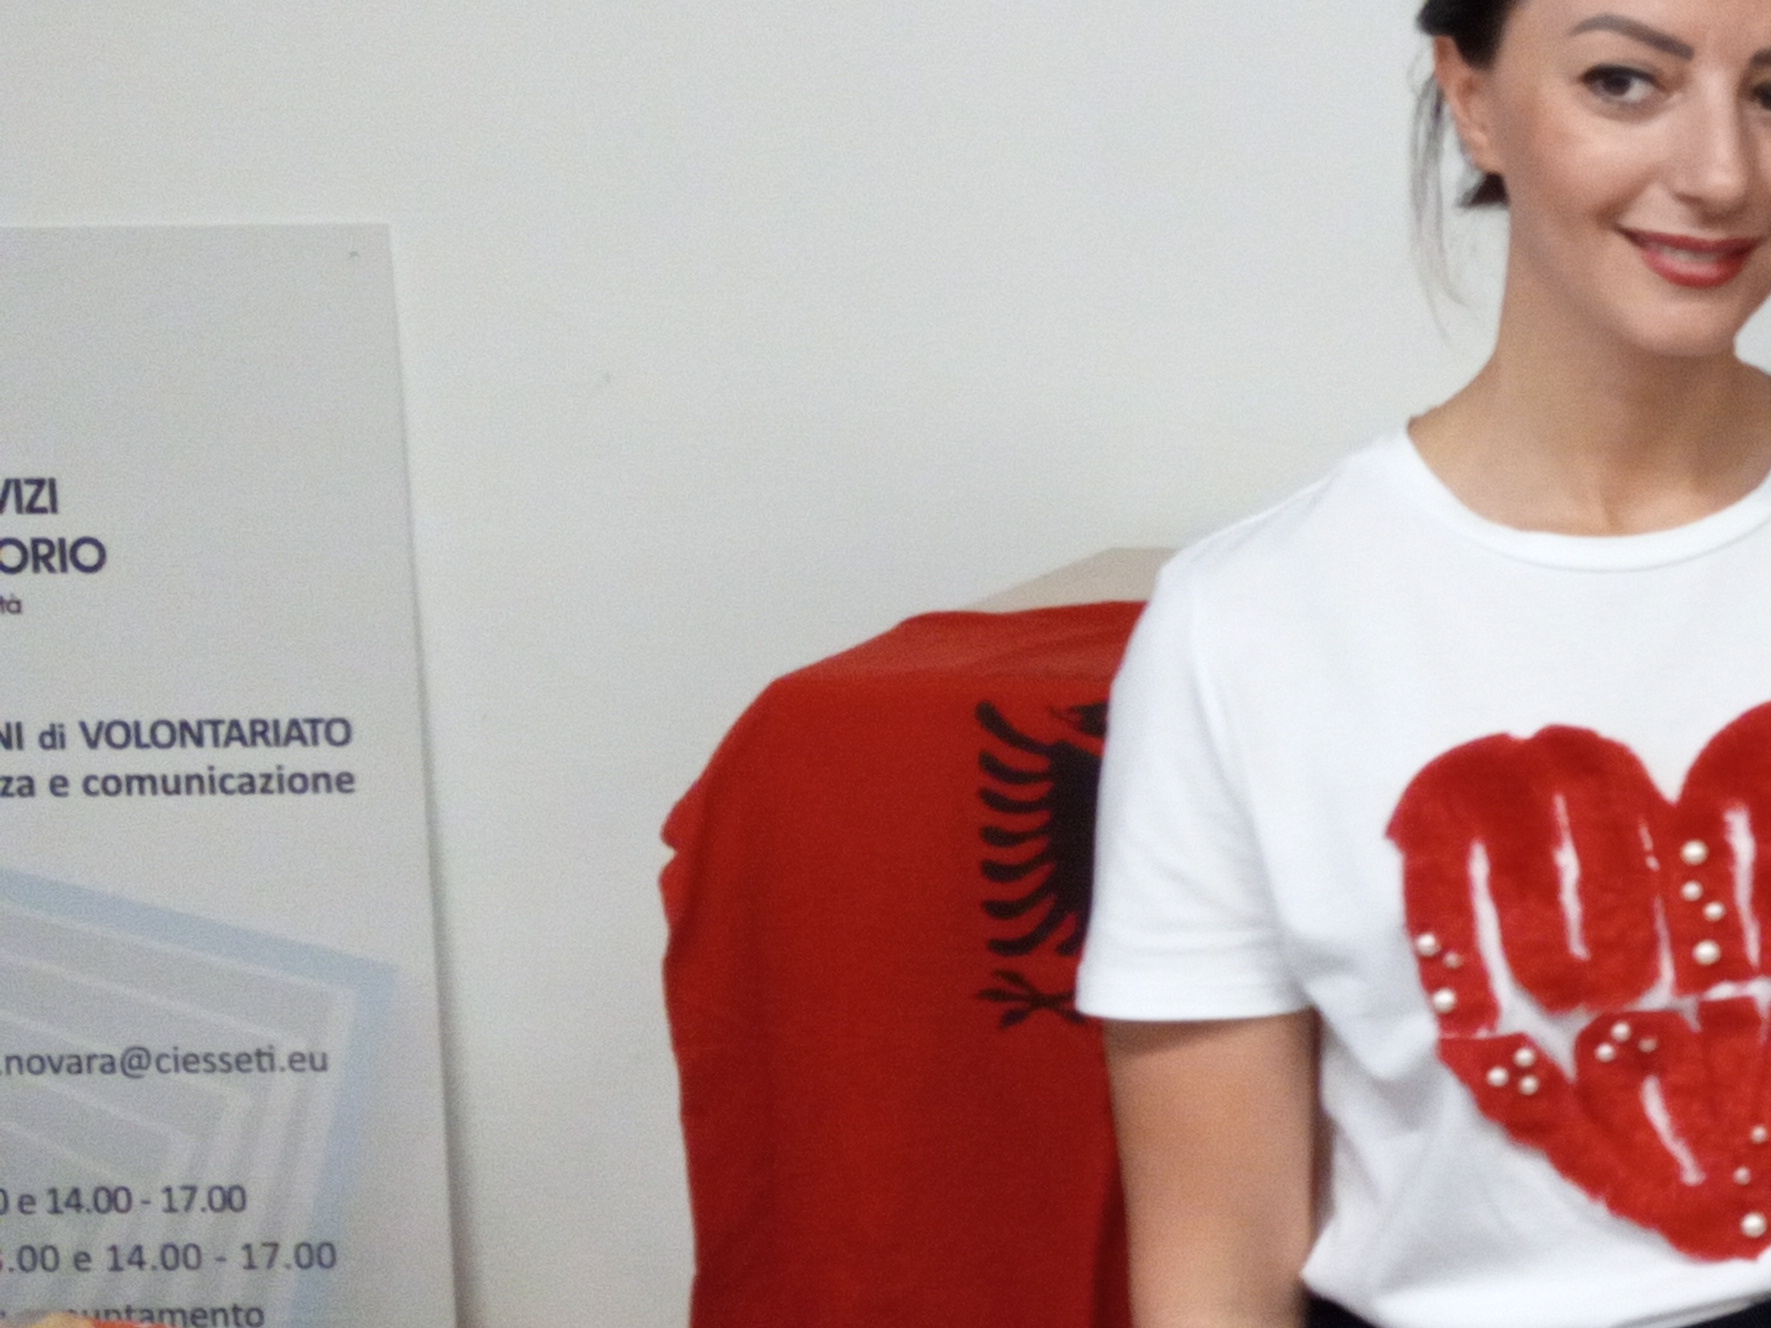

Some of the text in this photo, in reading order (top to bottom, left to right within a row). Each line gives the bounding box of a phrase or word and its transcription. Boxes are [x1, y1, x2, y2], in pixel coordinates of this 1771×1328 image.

[0, 536, 107, 574] ORIO
[38, 723, 66, 750] di
[79, 717, 353, 750] VOLONTARIATO
[0, 765, 356, 798] za e comunicazione
[17, 1193, 37, 1215] e
[45, 1185, 133, 1215] 14.00
[161, 1184, 248, 1214] 17.00
[0, 1244, 60, 1273] .00
[73, 1251, 92, 1272] e
[106, 1243, 203, 1273] 14.00
[242, 1241, 337, 1270] 17.00
